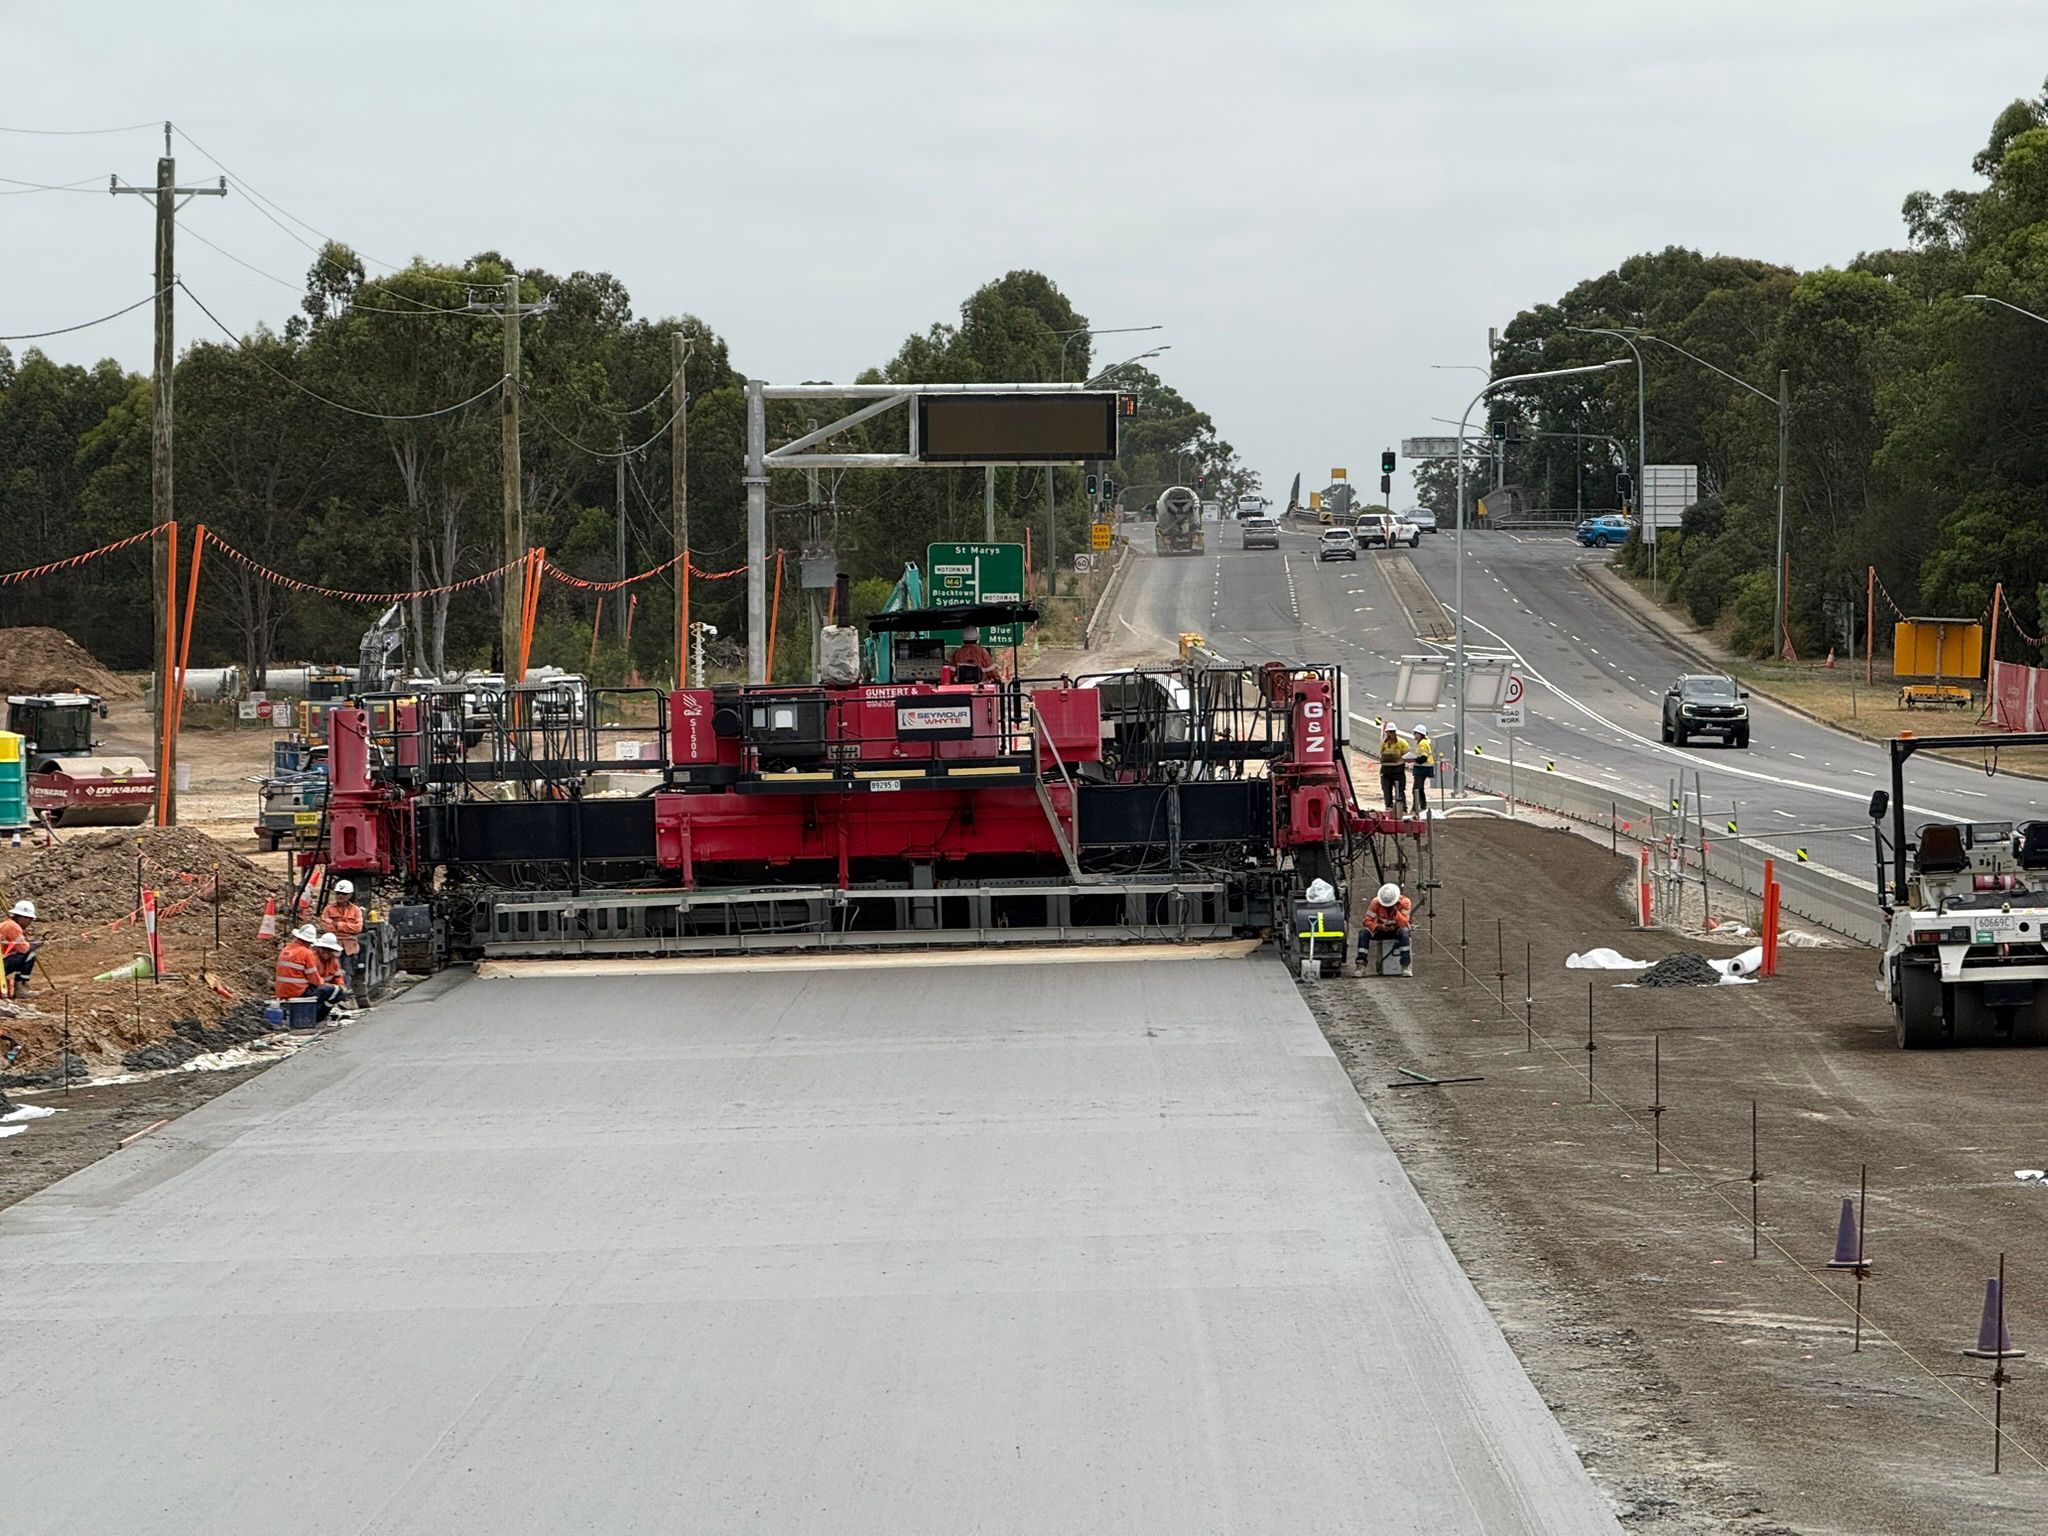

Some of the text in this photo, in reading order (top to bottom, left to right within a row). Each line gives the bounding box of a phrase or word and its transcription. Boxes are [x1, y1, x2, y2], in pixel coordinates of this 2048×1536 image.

[970, 547, 1001, 556] Marys
[936, 598, 971, 606] Sydney
[990, 626, 1011, 634] Blue
[989, 635, 1013, 643] Mtns
[865, 687, 919, 696] GUNTERT &
[917, 711, 968, 719] SEYMOUR
[689, 718, 697, 759] S1500
[96, 786, 155, 794] DYNAPAC
